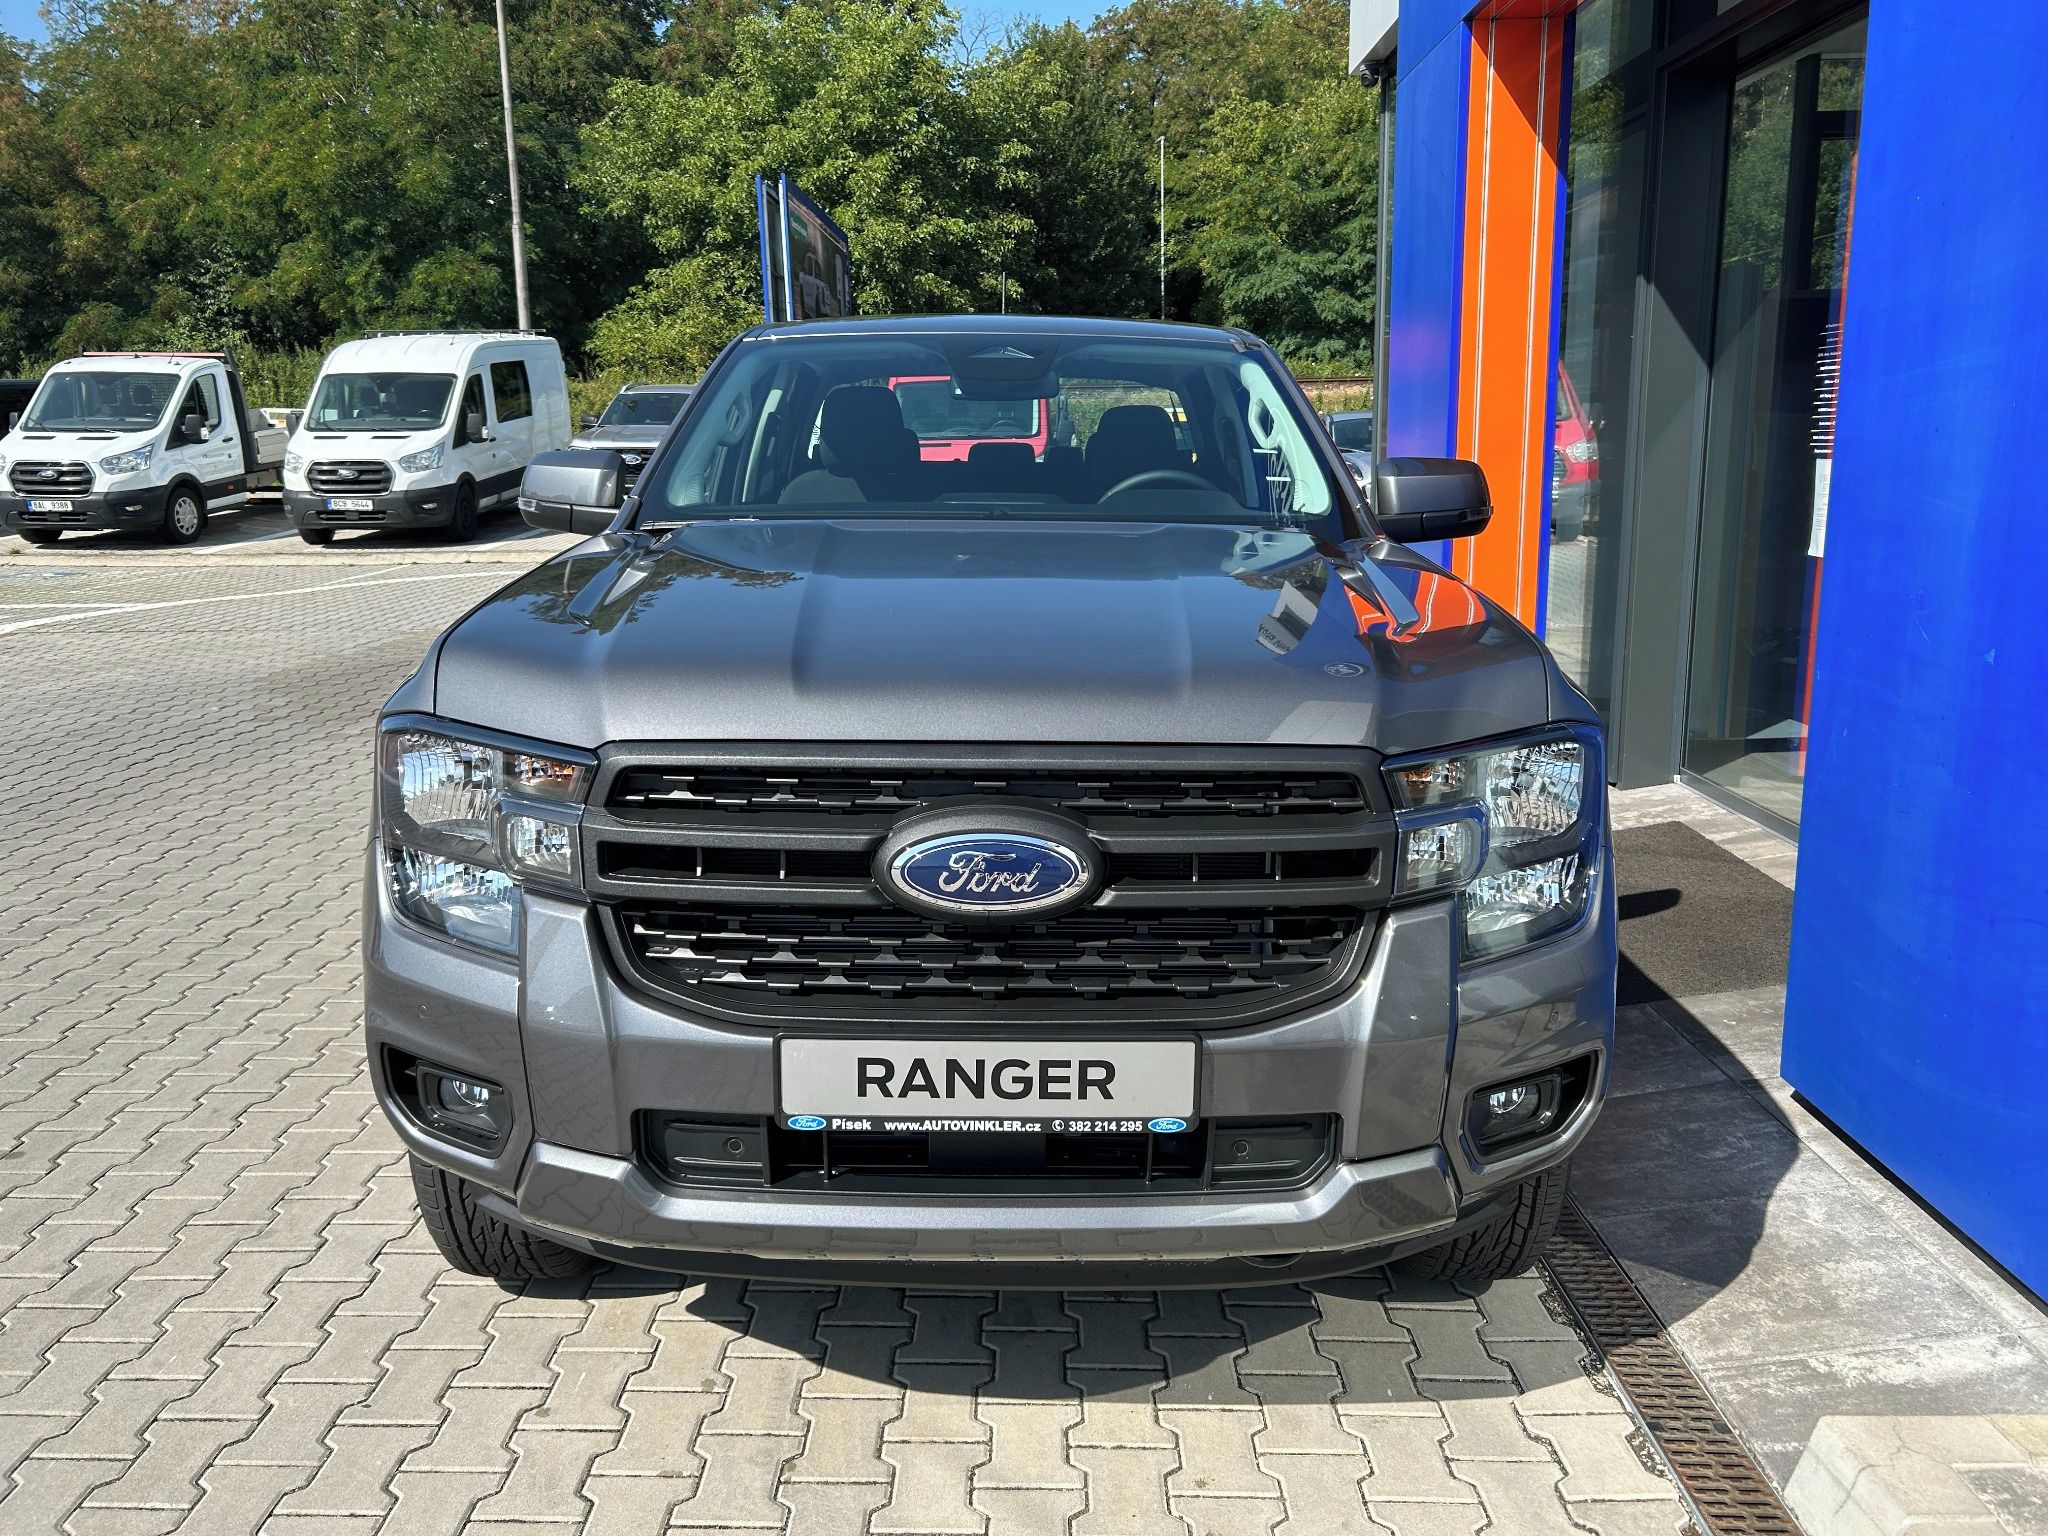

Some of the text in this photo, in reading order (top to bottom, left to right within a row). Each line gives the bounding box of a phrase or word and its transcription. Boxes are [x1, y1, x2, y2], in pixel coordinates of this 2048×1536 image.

[938, 850, 1043, 893] Ford
[857, 1057, 1117, 1101] RANGER
[831, 1118, 1143, 1132] Písek www.AUTOVINKLER.cz 382 214 295
